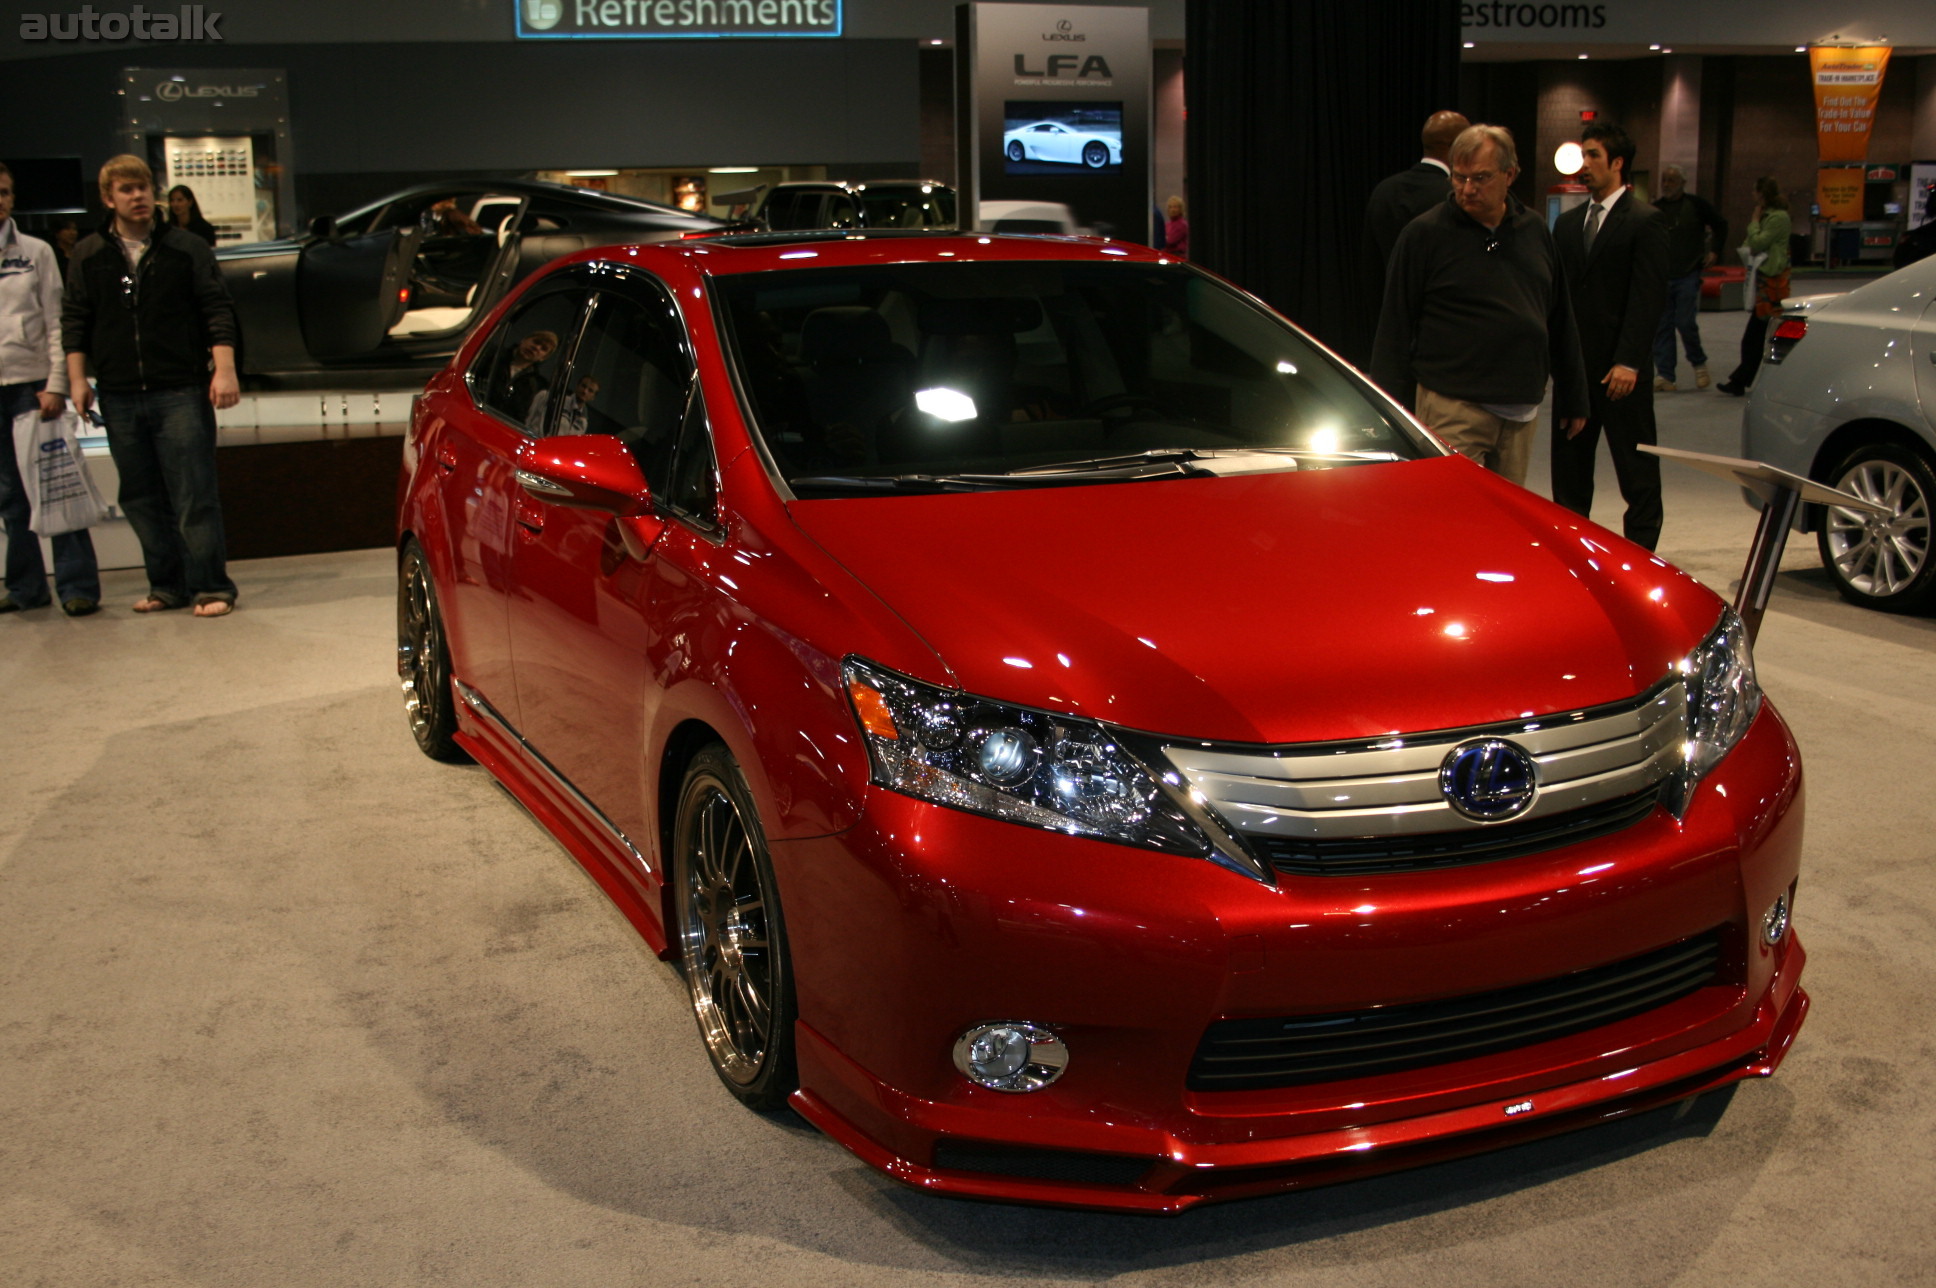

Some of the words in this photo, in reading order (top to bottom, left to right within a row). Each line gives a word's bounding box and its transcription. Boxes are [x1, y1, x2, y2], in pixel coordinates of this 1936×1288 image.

[576, 0, 835, 26] Refreshments
[1461, 0, 1606, 28] estrooms
[1042, 33, 1086, 42] LEXUS
[1014, 54, 1113, 78] LFA
[184, 85, 259, 98] LEXUS
[1823, 96, 1838, 106] Find
[1840, 96, 1852, 106] Out
[1854, 96, 1867, 106] The
[1850, 108, 1871, 119] Value
[1820, 121, 1832, 132] For
[1834, 121, 1851, 132] Your
